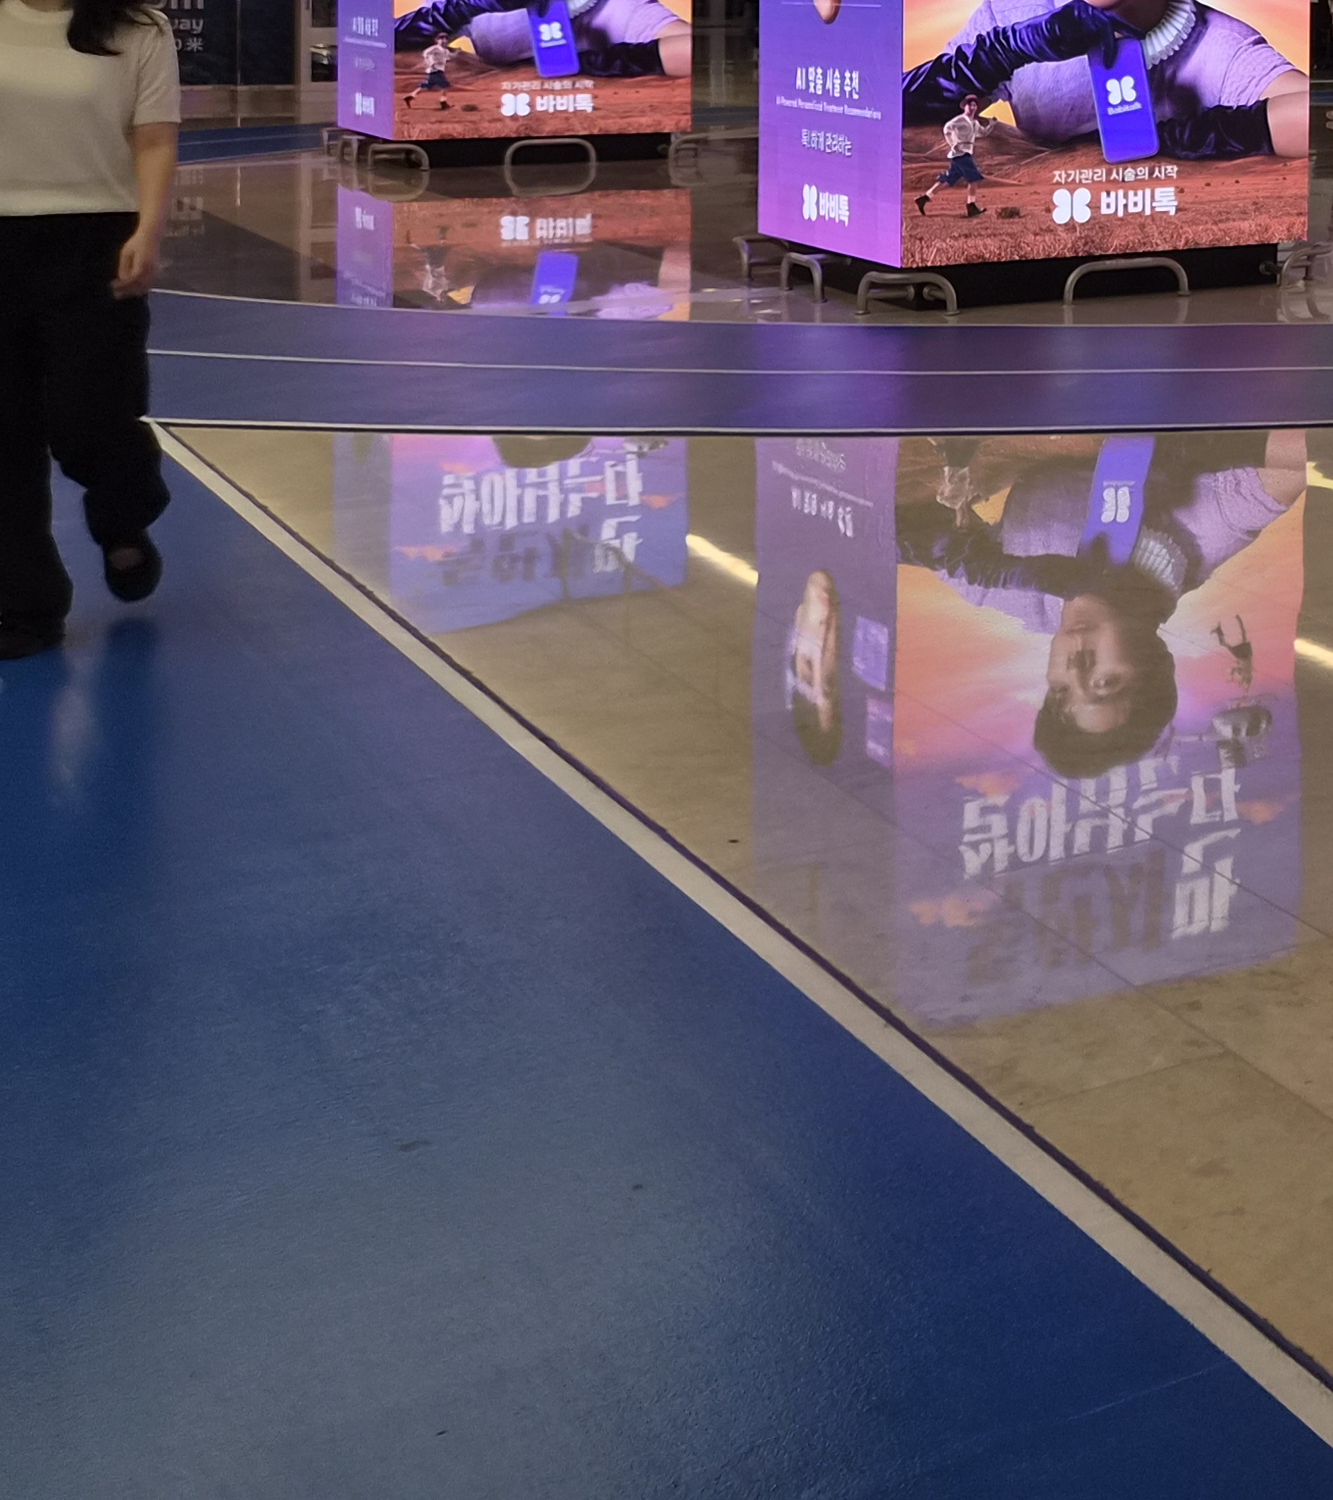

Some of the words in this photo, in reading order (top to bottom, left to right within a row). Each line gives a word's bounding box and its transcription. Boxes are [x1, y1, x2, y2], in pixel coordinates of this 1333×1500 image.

[796, 66, 806, 90] AI
[808, 66, 824, 95] 맞춤
[825, 67, 841, 97] 시술
[844, 69, 860, 99] 추천
[536, 93, 595, 113] 바비톡
[1052, 168, 1106, 185] 자기관리
[1110, 167, 1149, 182] 시술의
[1153, 165, 1179, 180] 시작
[819, 191, 850, 227] 바비톡
[1100, 187, 1179, 217] 바비톡
